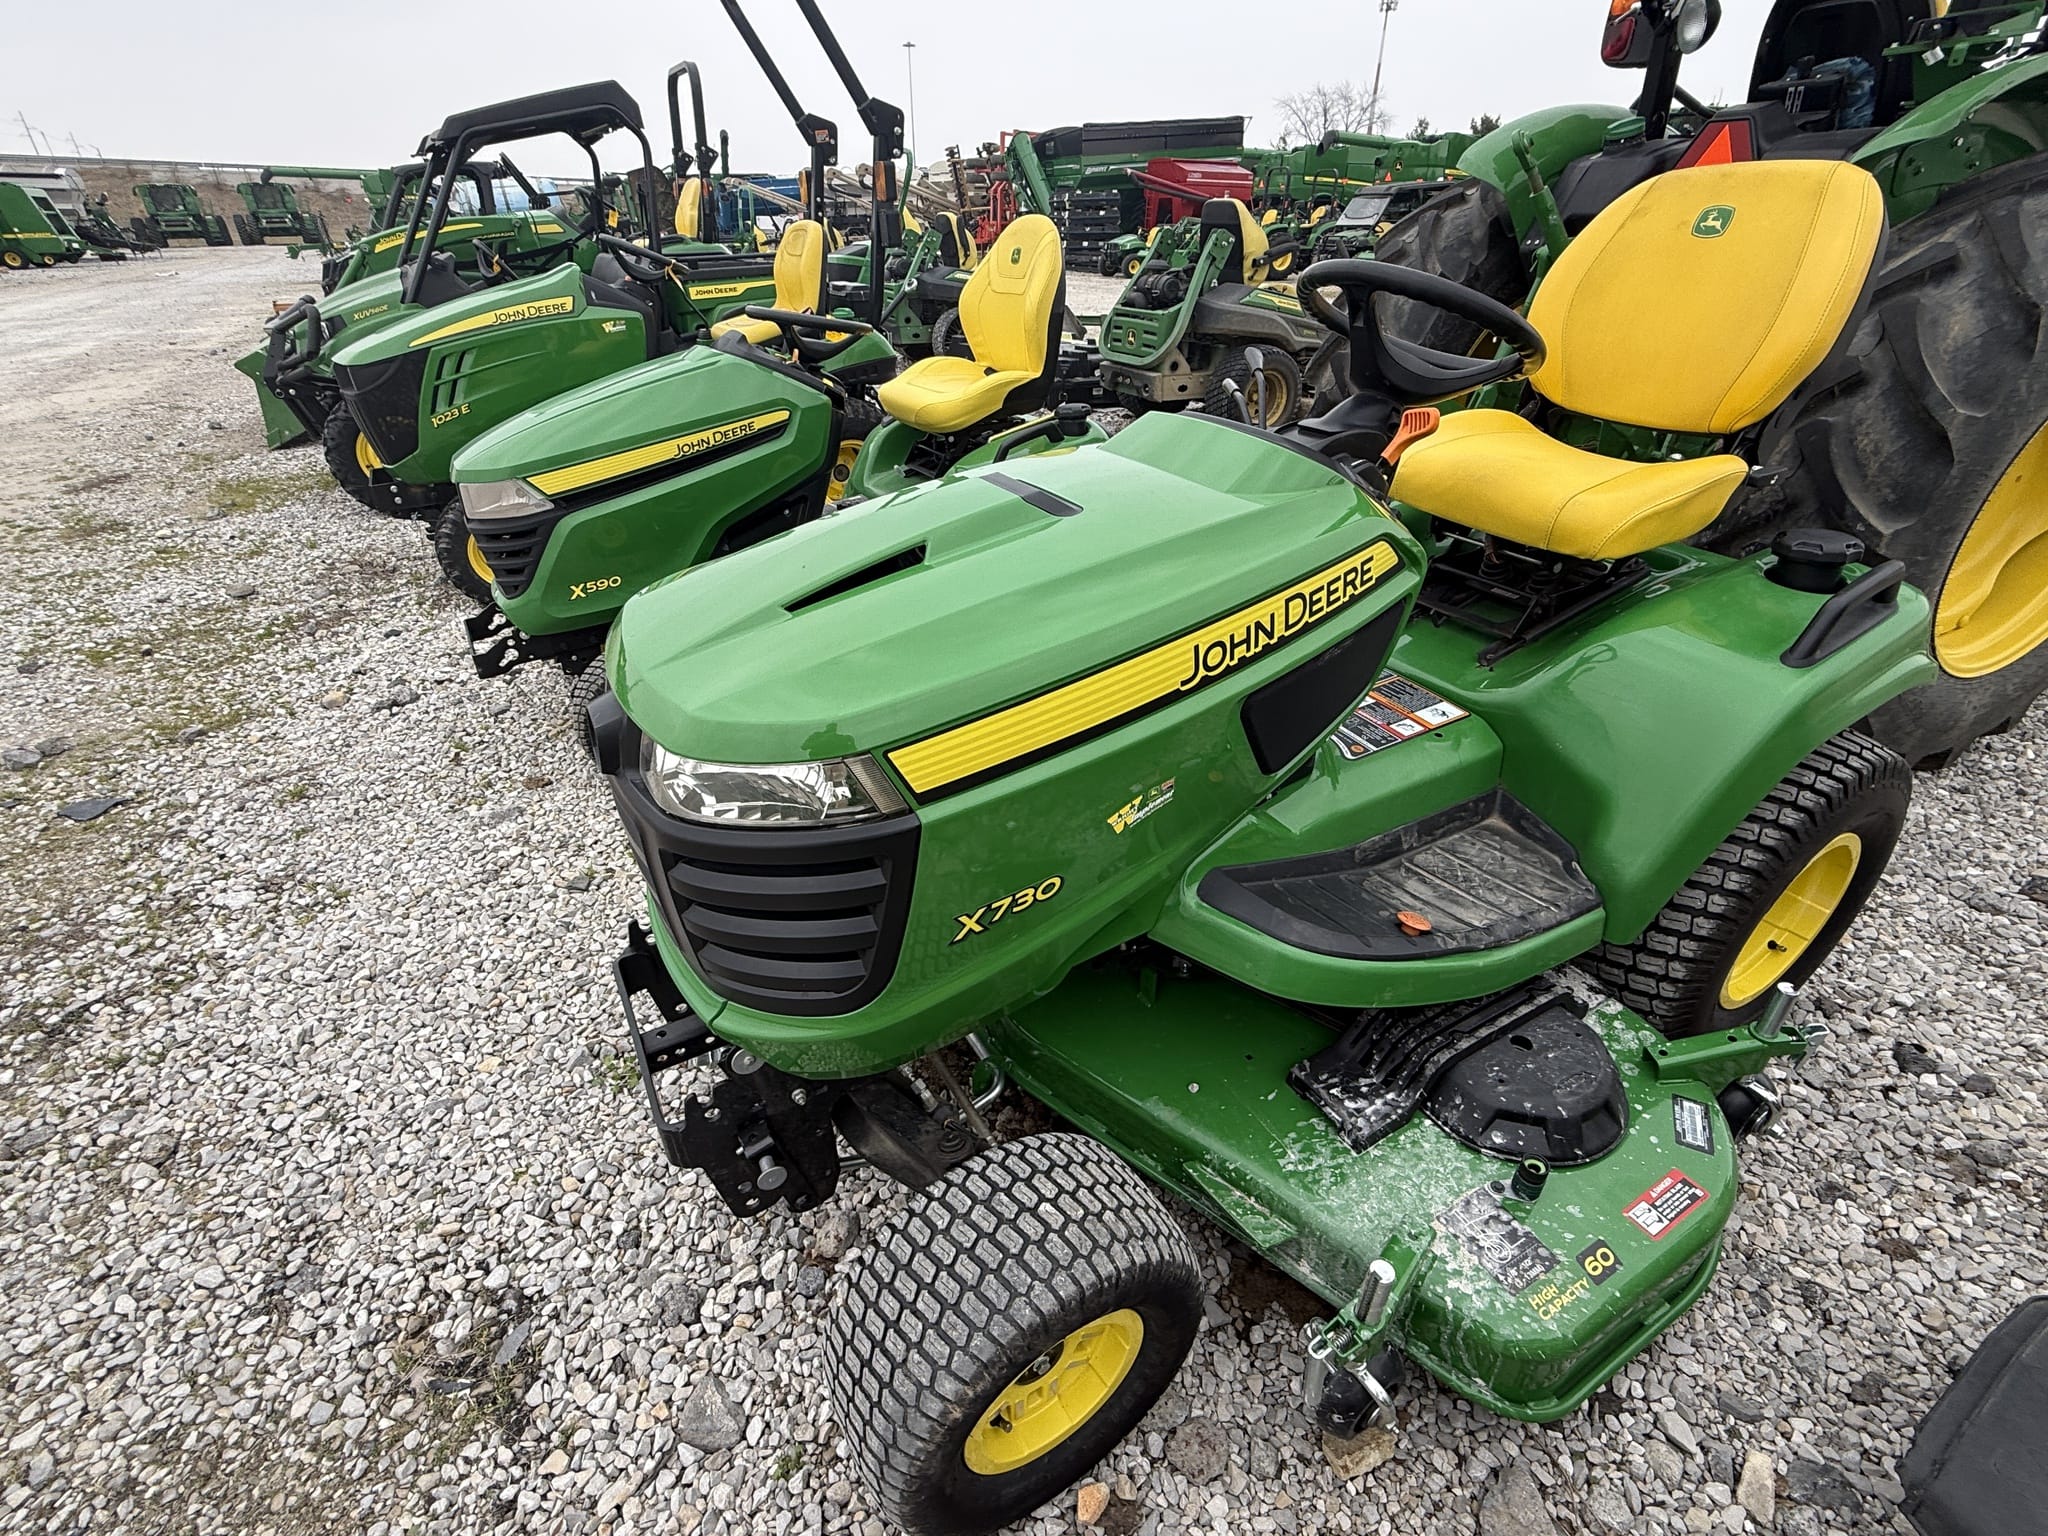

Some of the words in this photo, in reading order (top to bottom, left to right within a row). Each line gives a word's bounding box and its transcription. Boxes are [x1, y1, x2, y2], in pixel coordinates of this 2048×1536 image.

[492, 310, 525, 324] JOHN
[527, 302, 568, 316] DEERE
[431, 410, 460, 428] 1023
[461, 403, 471, 414] E
[674, 436, 711, 457] JOHN
[712, 421, 756, 444] DEERE
[569, 575, 622, 602] X590
[1180, 611, 1276, 688] JOHN
[1282, 553, 1376, 639] DEERE
[952, 876, 1063, 943] X730
[1584, 1247, 1615, 1276] 60
[1528, 1283, 1559, 1310] HIGH
[1538, 1276, 1590, 1321] CAPACITY
